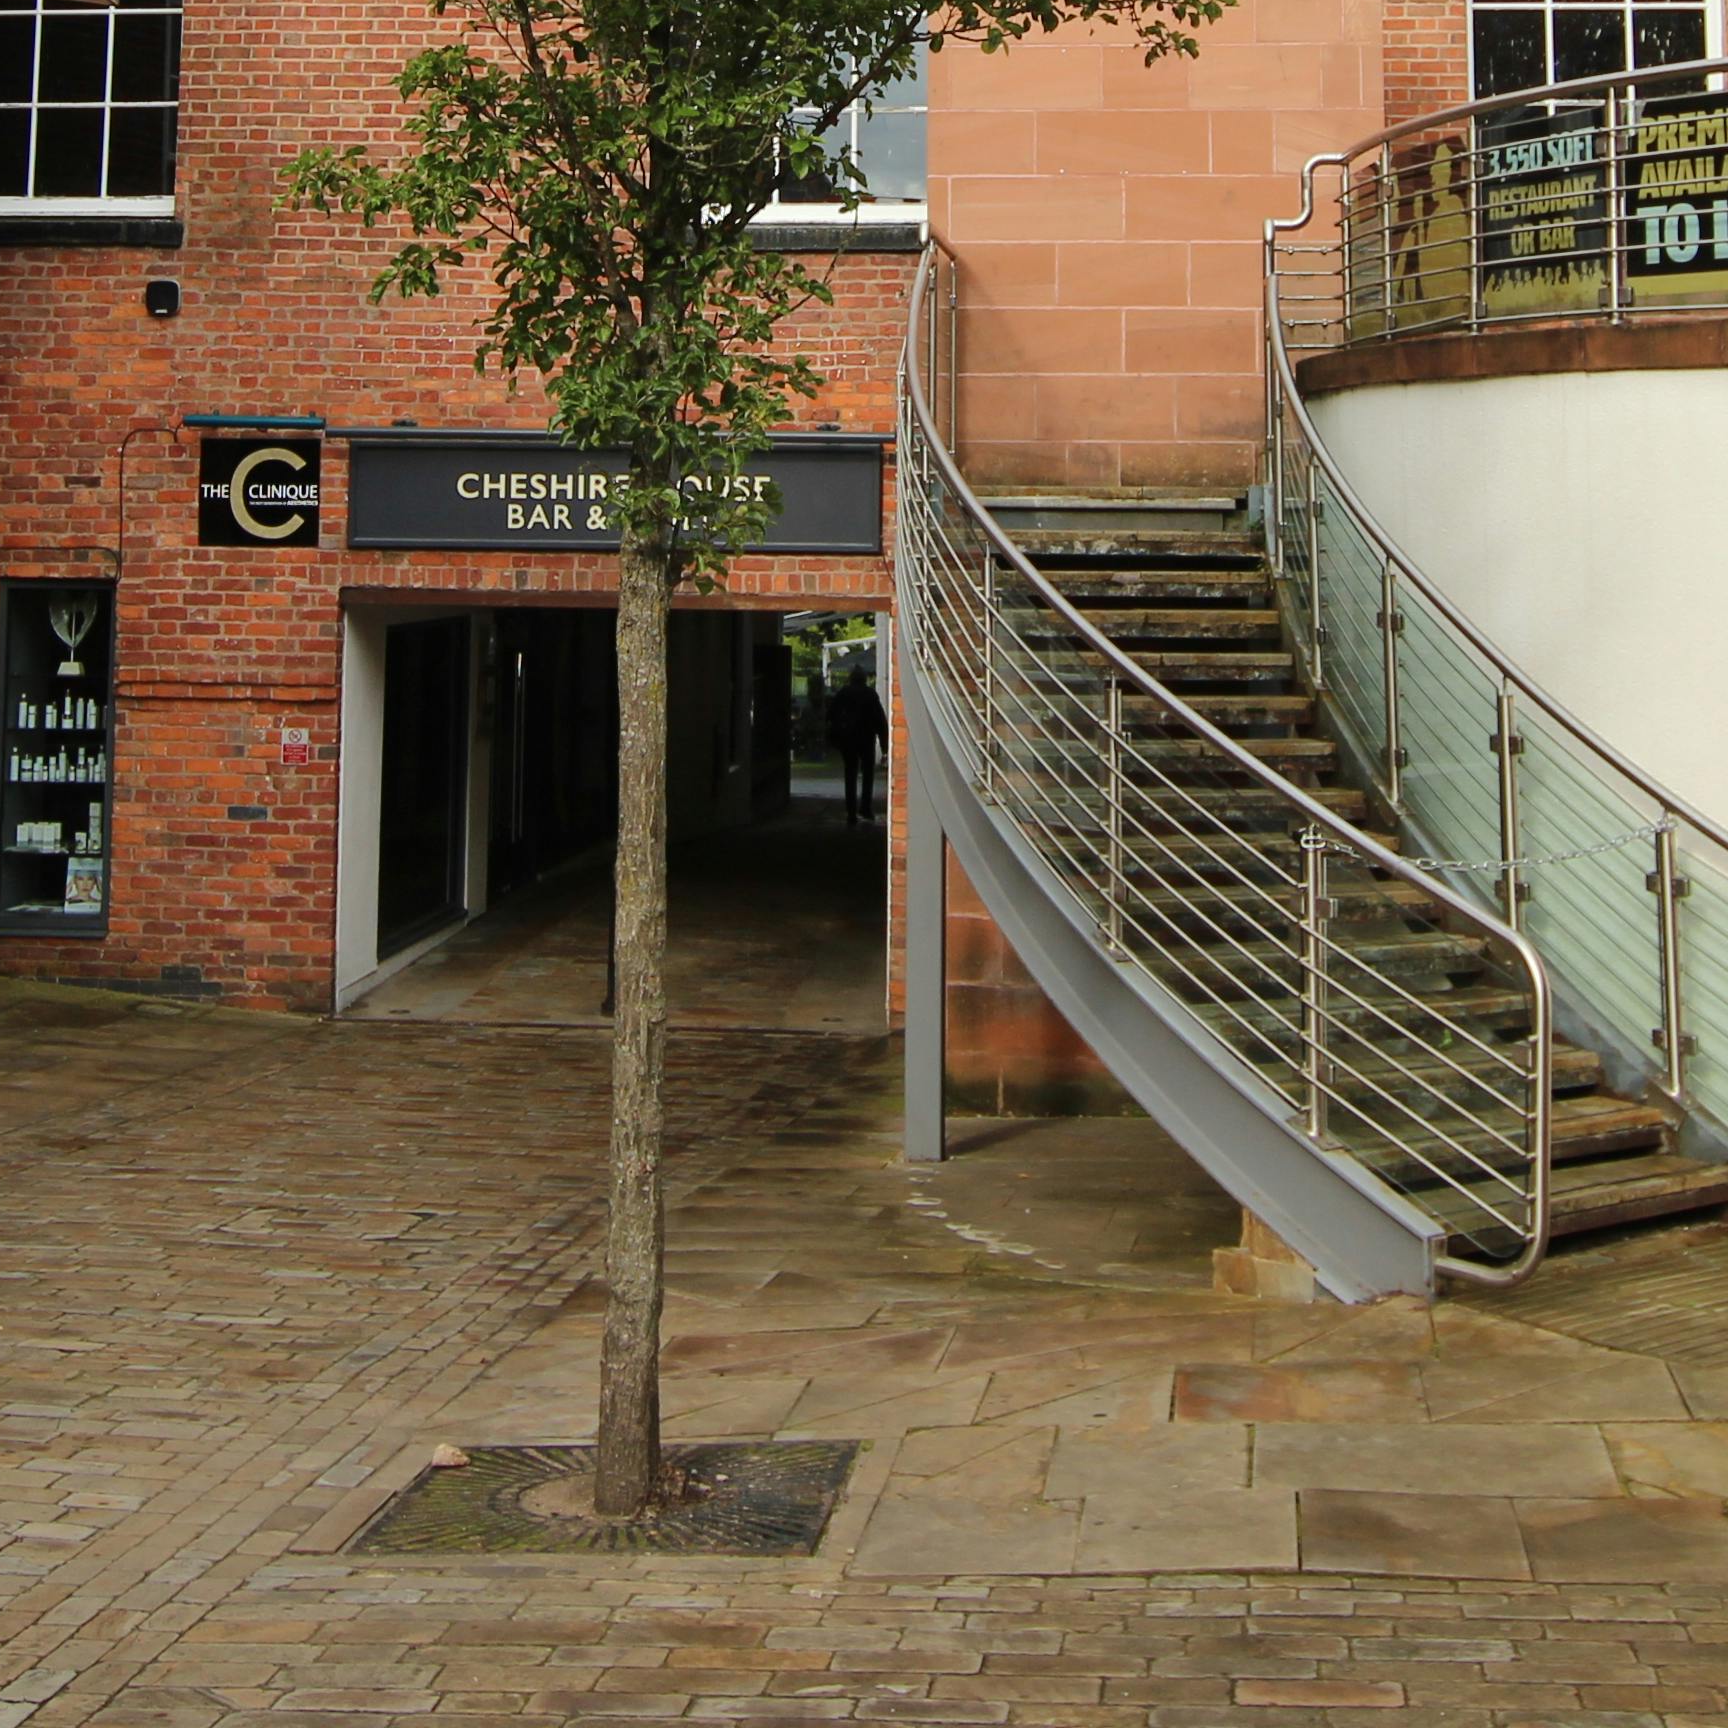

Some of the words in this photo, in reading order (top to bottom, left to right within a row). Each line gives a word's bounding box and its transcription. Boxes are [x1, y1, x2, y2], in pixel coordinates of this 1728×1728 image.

[1488, 174, 1597, 221] RESTAURANT
[1511, 223, 1536, 256] OR
[1539, 216, 1575, 251] BAR
[1636, 202, 1700, 265] TO
[201, 483, 230, 499] THE
[248, 483, 318, 500] CLINIQUE
[507, 504, 572, 530] BAR
[586, 505, 608, 530] &
